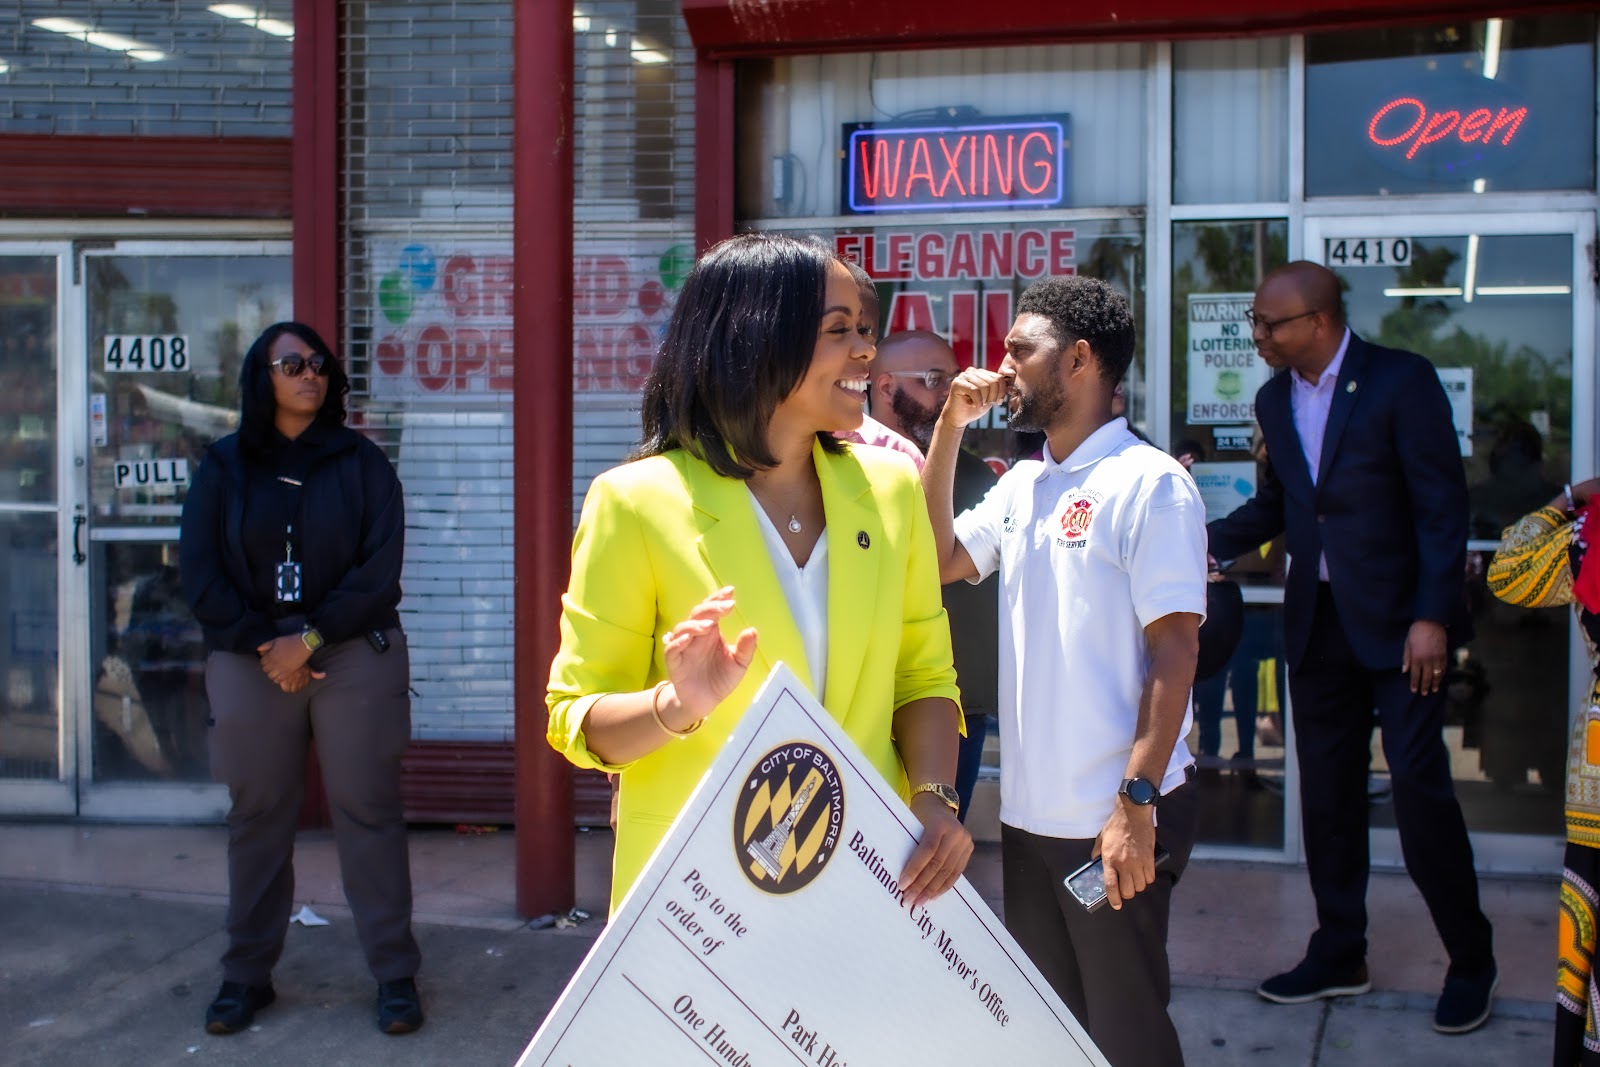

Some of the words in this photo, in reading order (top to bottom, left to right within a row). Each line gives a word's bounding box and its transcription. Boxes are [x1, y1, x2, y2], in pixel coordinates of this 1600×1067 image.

[1368, 98, 1527, 159] Open
[861, 132, 1053, 198] WAXING
[834, 229, 1077, 281] ELEGANCE
[1332, 239, 1409, 263] 4410
[1192, 303, 1256, 321] WARNIN
[1221, 324, 1239, 336] NO
[107, 337, 186, 370] 4408
[415, 324, 654, 392] OPENG
[1192, 339, 1257, 352] LOITERIN
[1204, 354, 1254, 368] POLICE
[1193, 404, 1257, 418] ENFORCE
[116, 461, 185, 485] PULL
[761, 748, 790, 774] CITY
[793, 747, 812, 759] OF
[812, 753, 841, 849] BALTIMORE
[683, 868, 711, 902] Pay
[709, 897, 726, 915] to
[724, 912, 747, 938] the
[665, 900, 704, 936] order
[702, 936, 725, 956] of
[909, 903, 936, 940] City
[933, 929, 980, 991] Mayor's
[978, 983, 1010, 1027] Office
[673, 994, 705, 1031] One
[780, 1008, 820, 1057] Park
